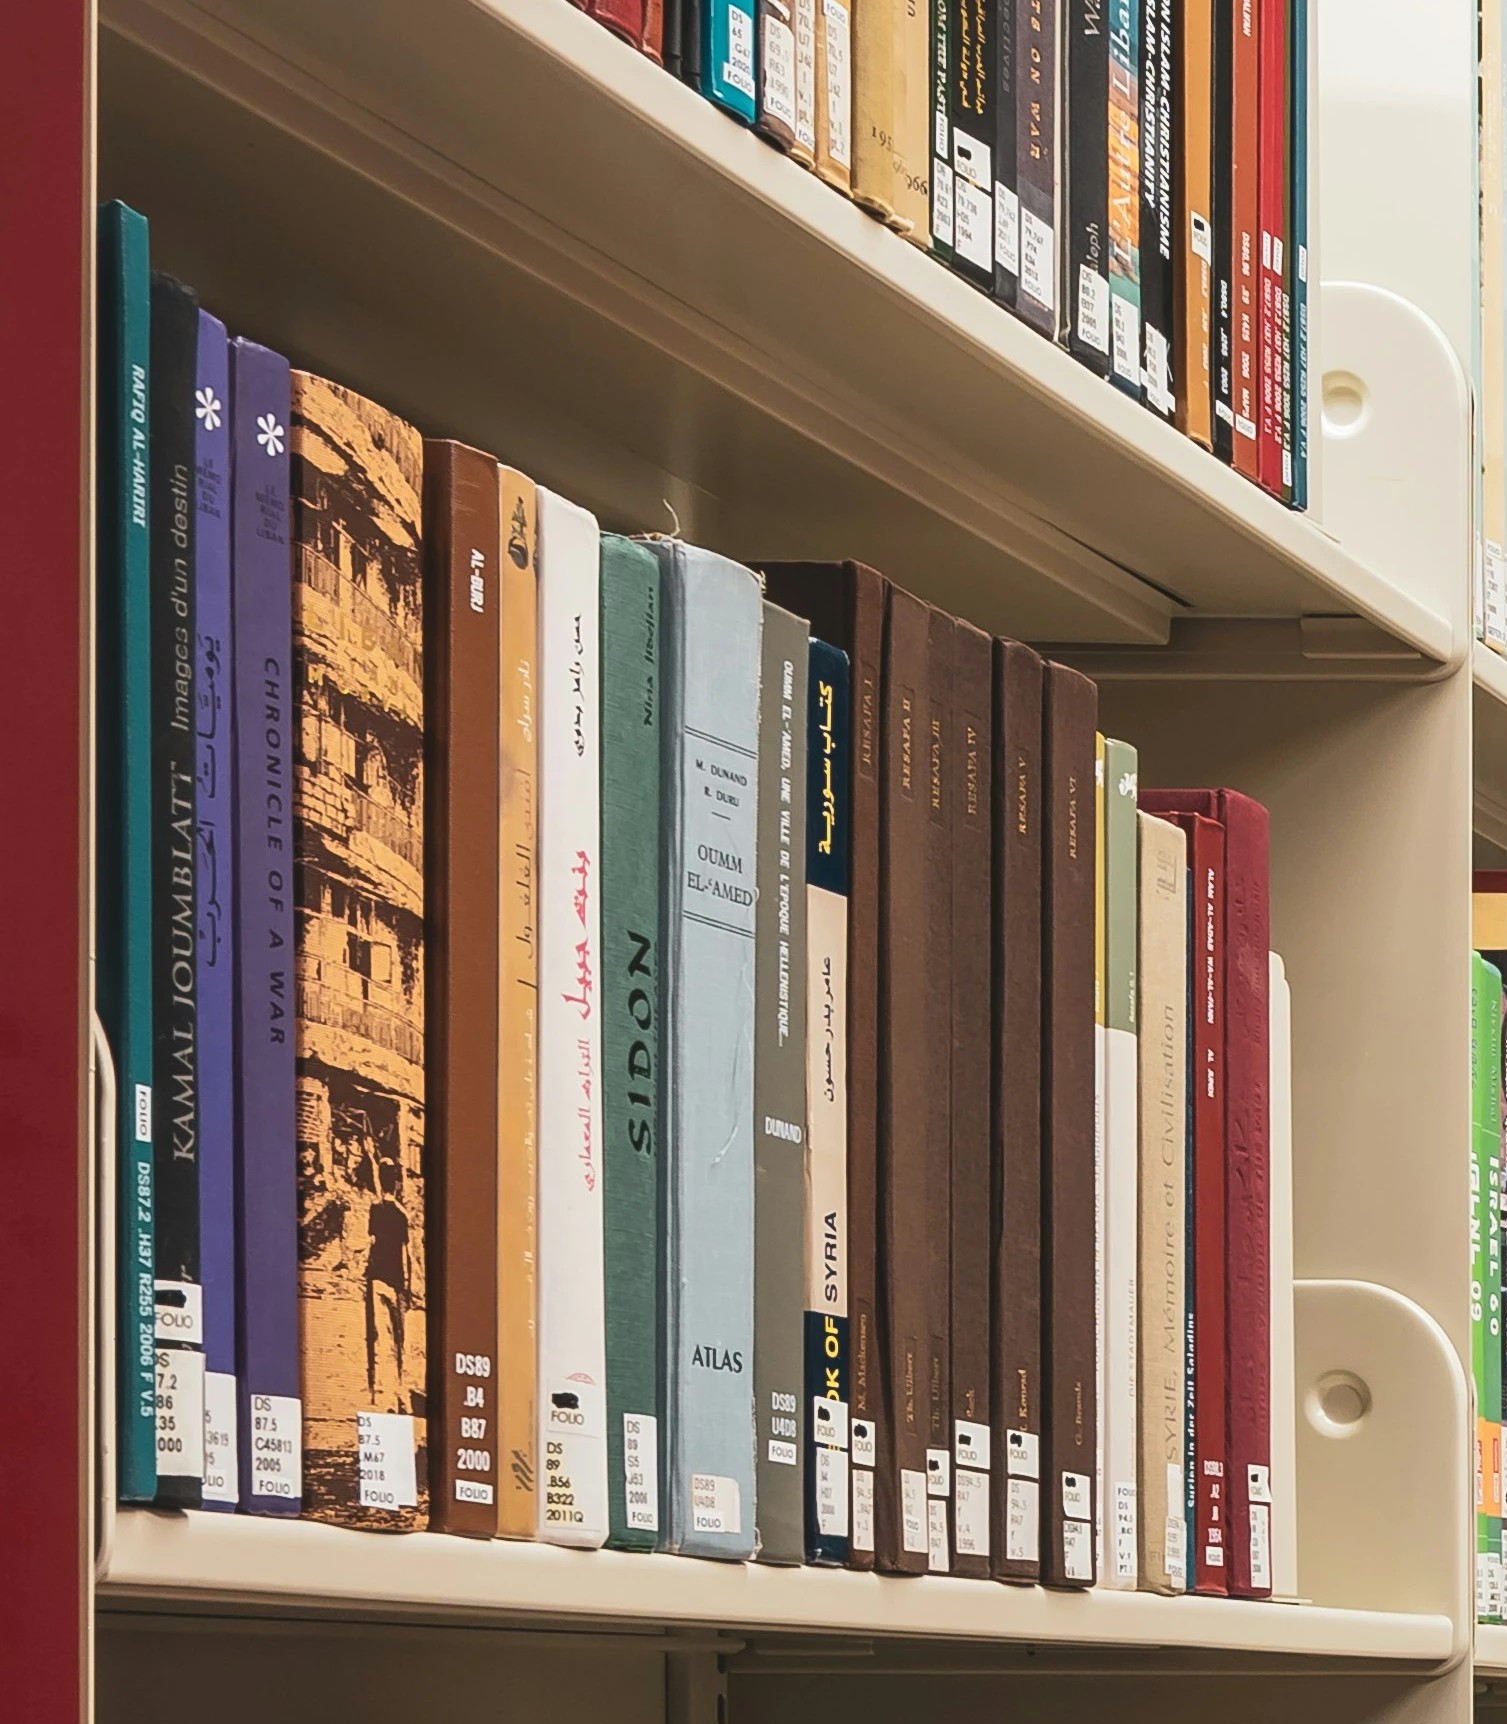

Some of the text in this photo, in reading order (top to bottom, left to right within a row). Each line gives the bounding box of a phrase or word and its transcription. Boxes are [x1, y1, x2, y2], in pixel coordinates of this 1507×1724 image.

[1158, 29, 1171, 260] ISLAM-CHRISTIANISME
[132, 364, 146, 527] RAFIQ AL-HARIRI
[171, 464, 188, 548] destin
[171, 559, 189, 617] d'un
[783, 660, 793, 700] OUMM
[711, 766, 748, 786] DUNAND
[781, 778, 791, 802] UNE
[780, 809, 791, 846] VILLE
[264, 657, 285, 1044] CHRONICLE OF A WAR
[697, 843, 742, 875] OUMM
[172, 761, 195, 1161] KAMAL JOUMBLATT
[627, 930, 652, 1153] SIDON
[825, 1212, 838, 1303] SYRIA
[1489, 1156, 1499, 1336] ISRAEL 60
[825, 1316, 839, 1357] OF
[456, 1354, 490, 1376] DS89
[692, 1346, 742, 1374] ATLAS
[461, 1416, 486, 1439] B87
[458, 1449, 490, 1470] 2000
[547, 1441, 563, 1456] DS
[547, 1458, 561, 1471] 89
[547, 1492, 574, 1506] B322
